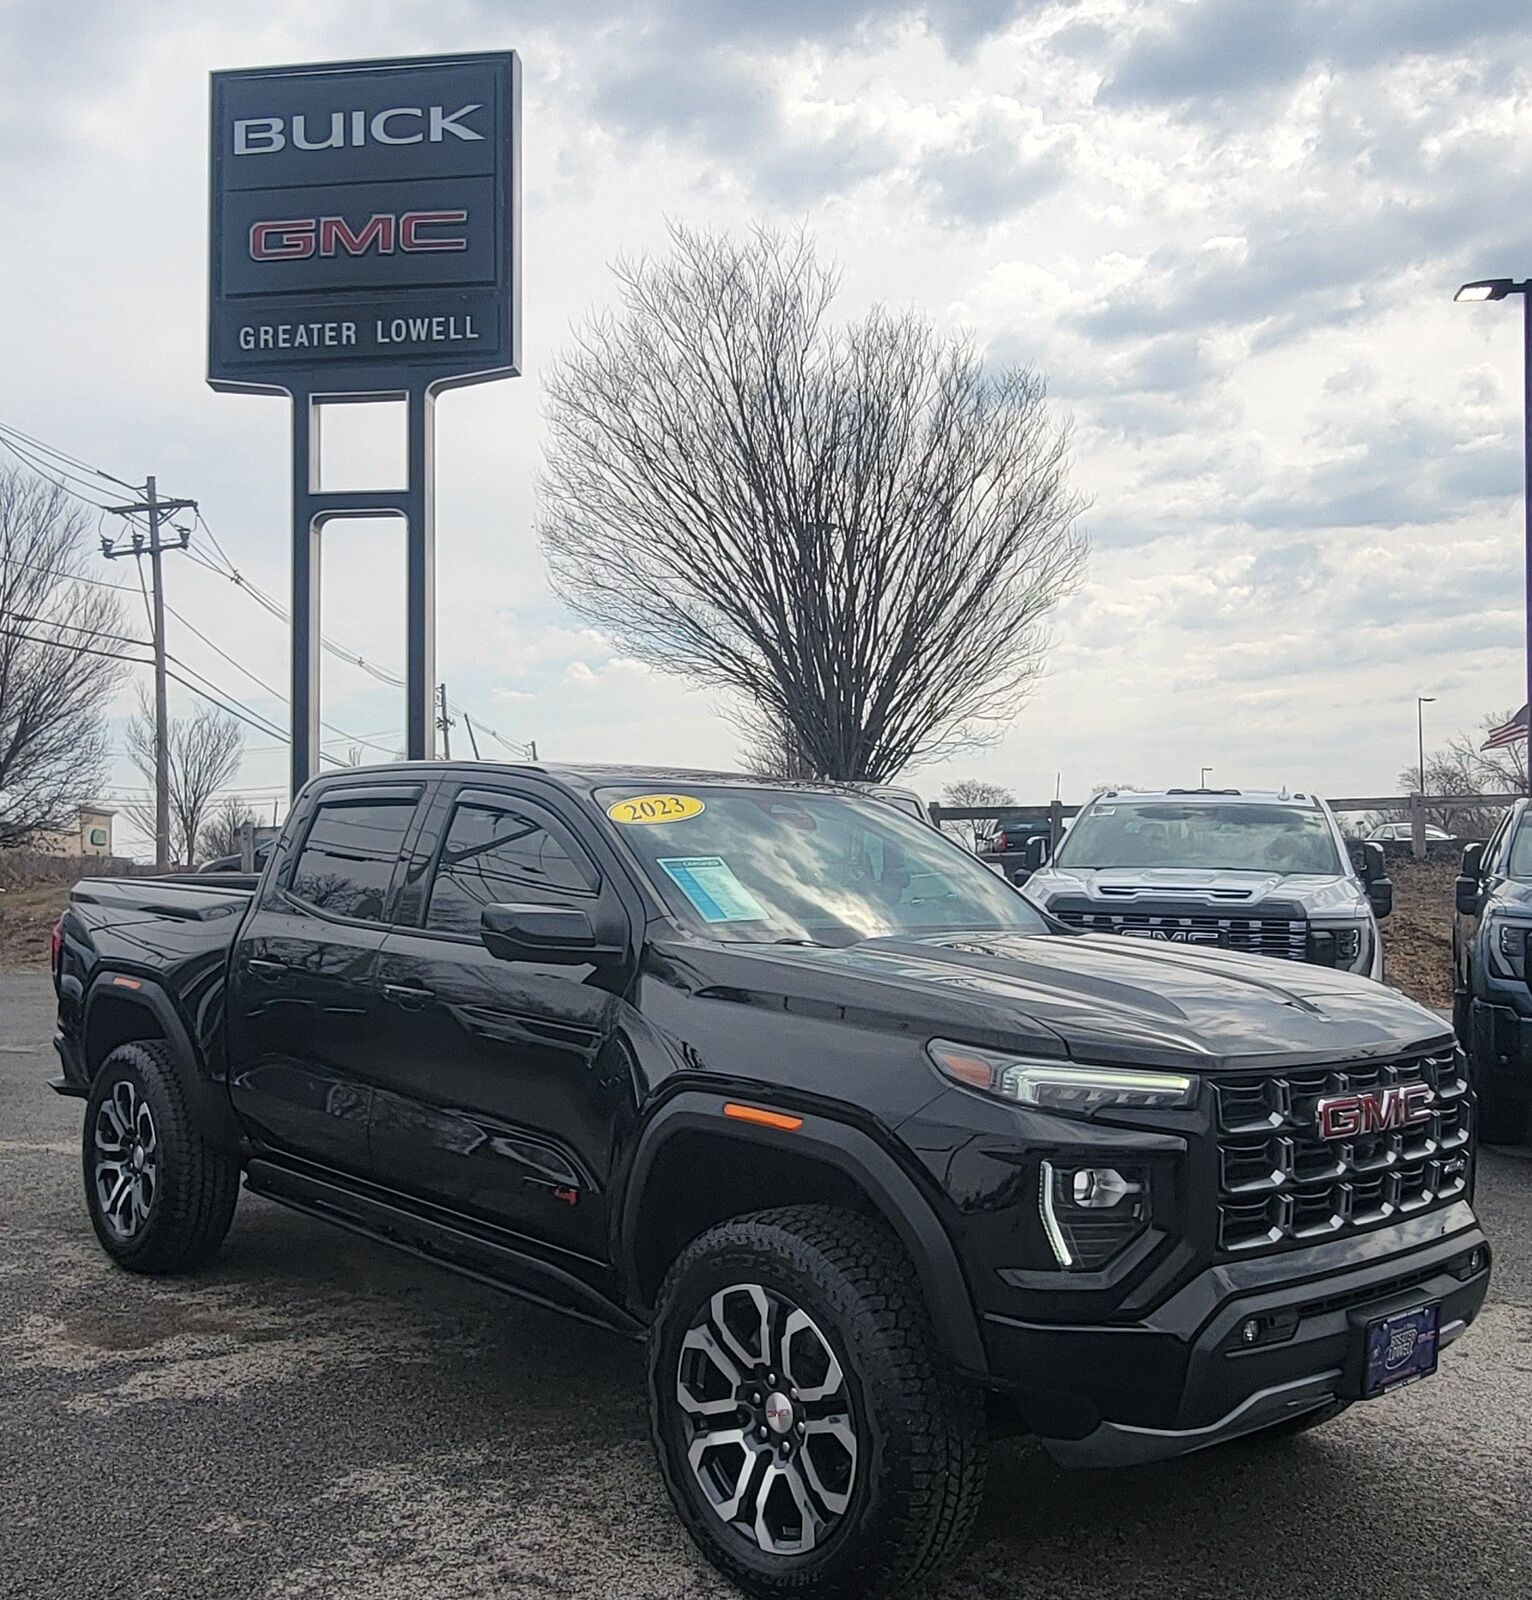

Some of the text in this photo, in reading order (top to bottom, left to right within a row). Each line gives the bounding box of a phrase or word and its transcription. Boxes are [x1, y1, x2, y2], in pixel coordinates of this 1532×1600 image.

[233, 104, 486, 155] BUICK
[249, 209, 468, 262] GMC
[239, 315, 479, 350] GREATER LOWELL
[624, 797, 686, 821] 2023
[1121, 929, 1219, 946] MC
[1317, 1083, 1436, 1142] GMC
